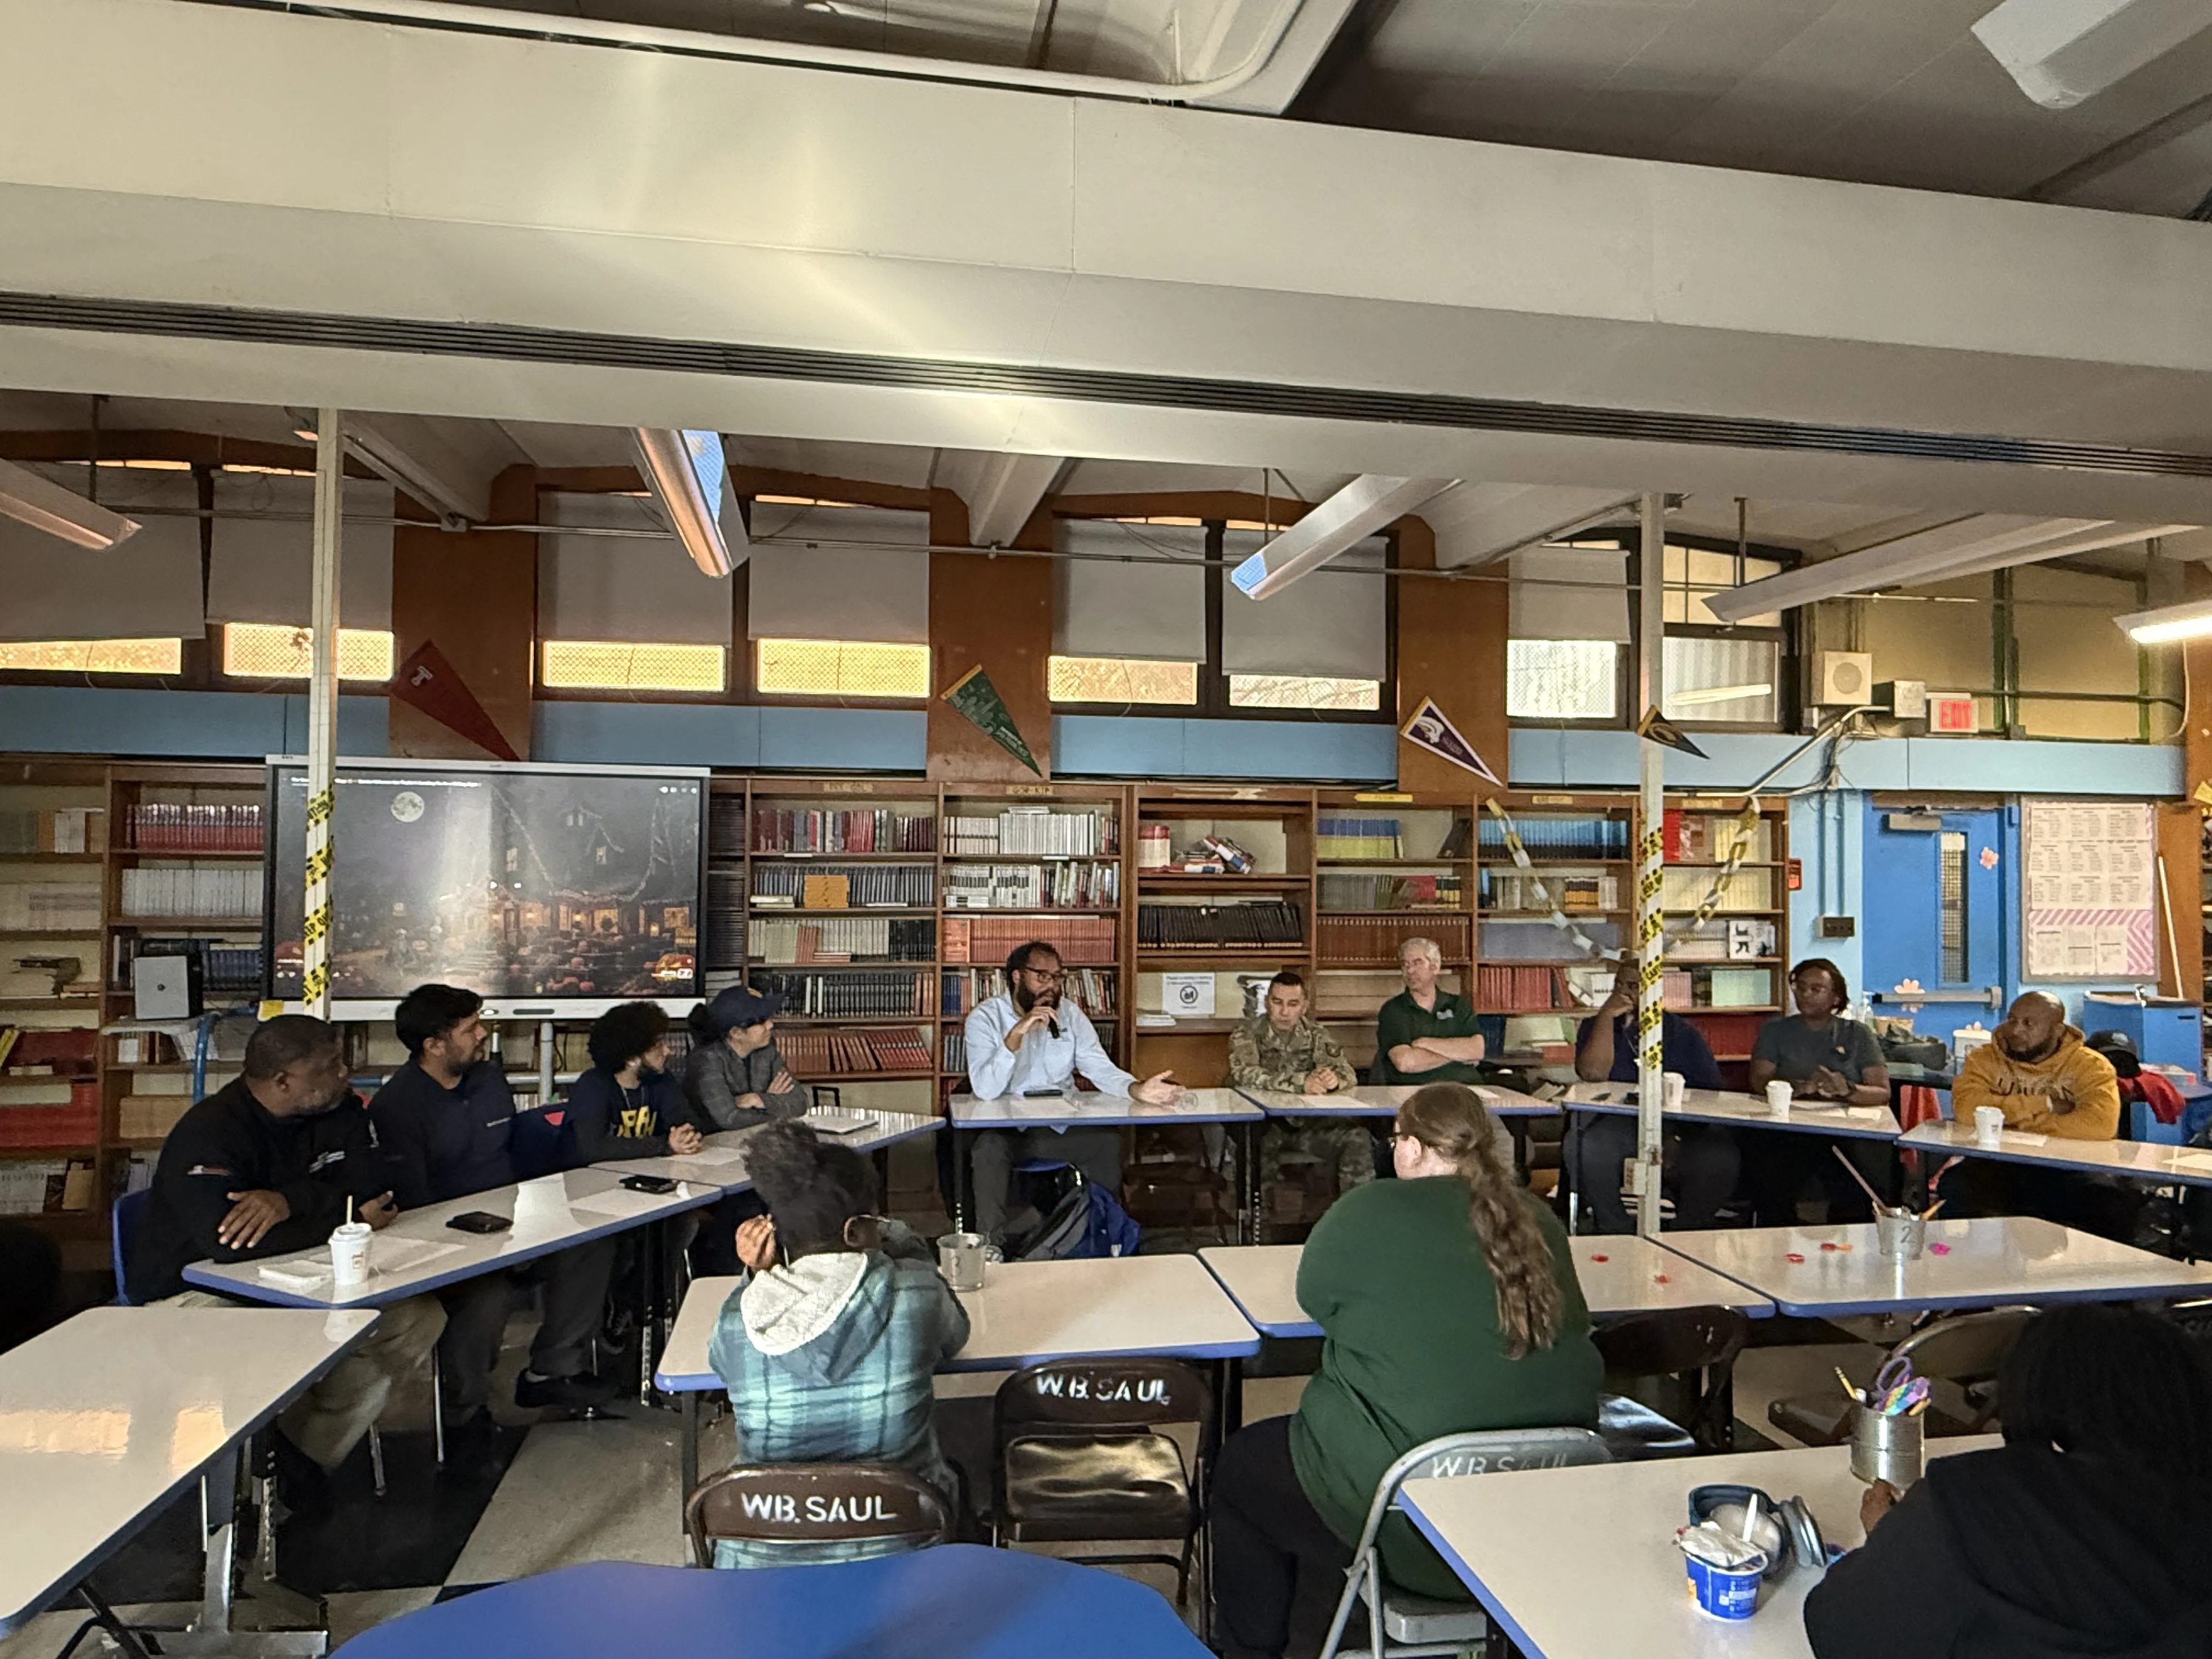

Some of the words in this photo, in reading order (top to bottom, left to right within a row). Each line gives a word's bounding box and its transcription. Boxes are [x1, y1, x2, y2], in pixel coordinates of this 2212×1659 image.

[411, 665, 433, 686] T
[1940, 701, 1972, 729] EXIT
[1900, 1226, 1915, 1243] 2
[1096, 1378, 1172, 1406] SAUL
[805, 1496, 898, 1522] SAUL
